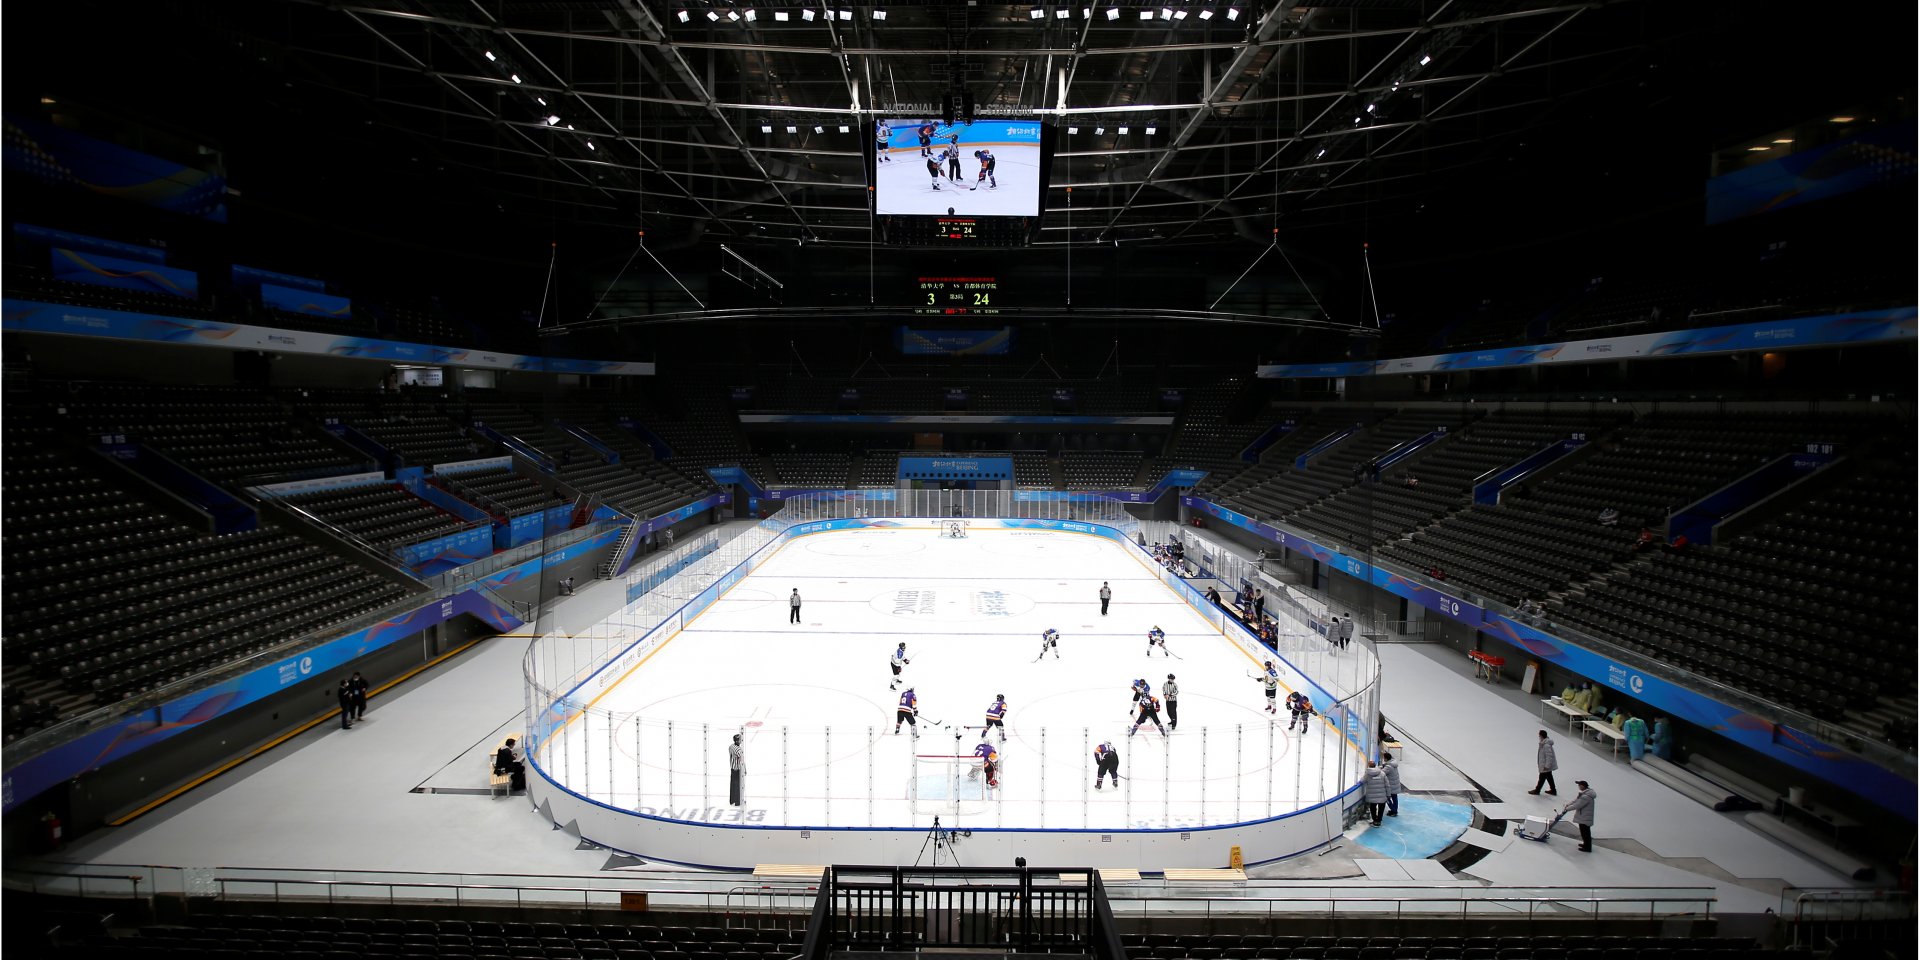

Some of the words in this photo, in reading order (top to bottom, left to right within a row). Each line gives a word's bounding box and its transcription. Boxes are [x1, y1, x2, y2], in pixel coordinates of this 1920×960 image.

[883, 103, 933, 115] NATIONAL
[986, 104, 1034, 116] STADIUM
[941, 226, 946, 234] 3
[963, 226, 972, 234] 24
[927, 293, 935, 305] 3
[973, 293, 990, 305] 24
